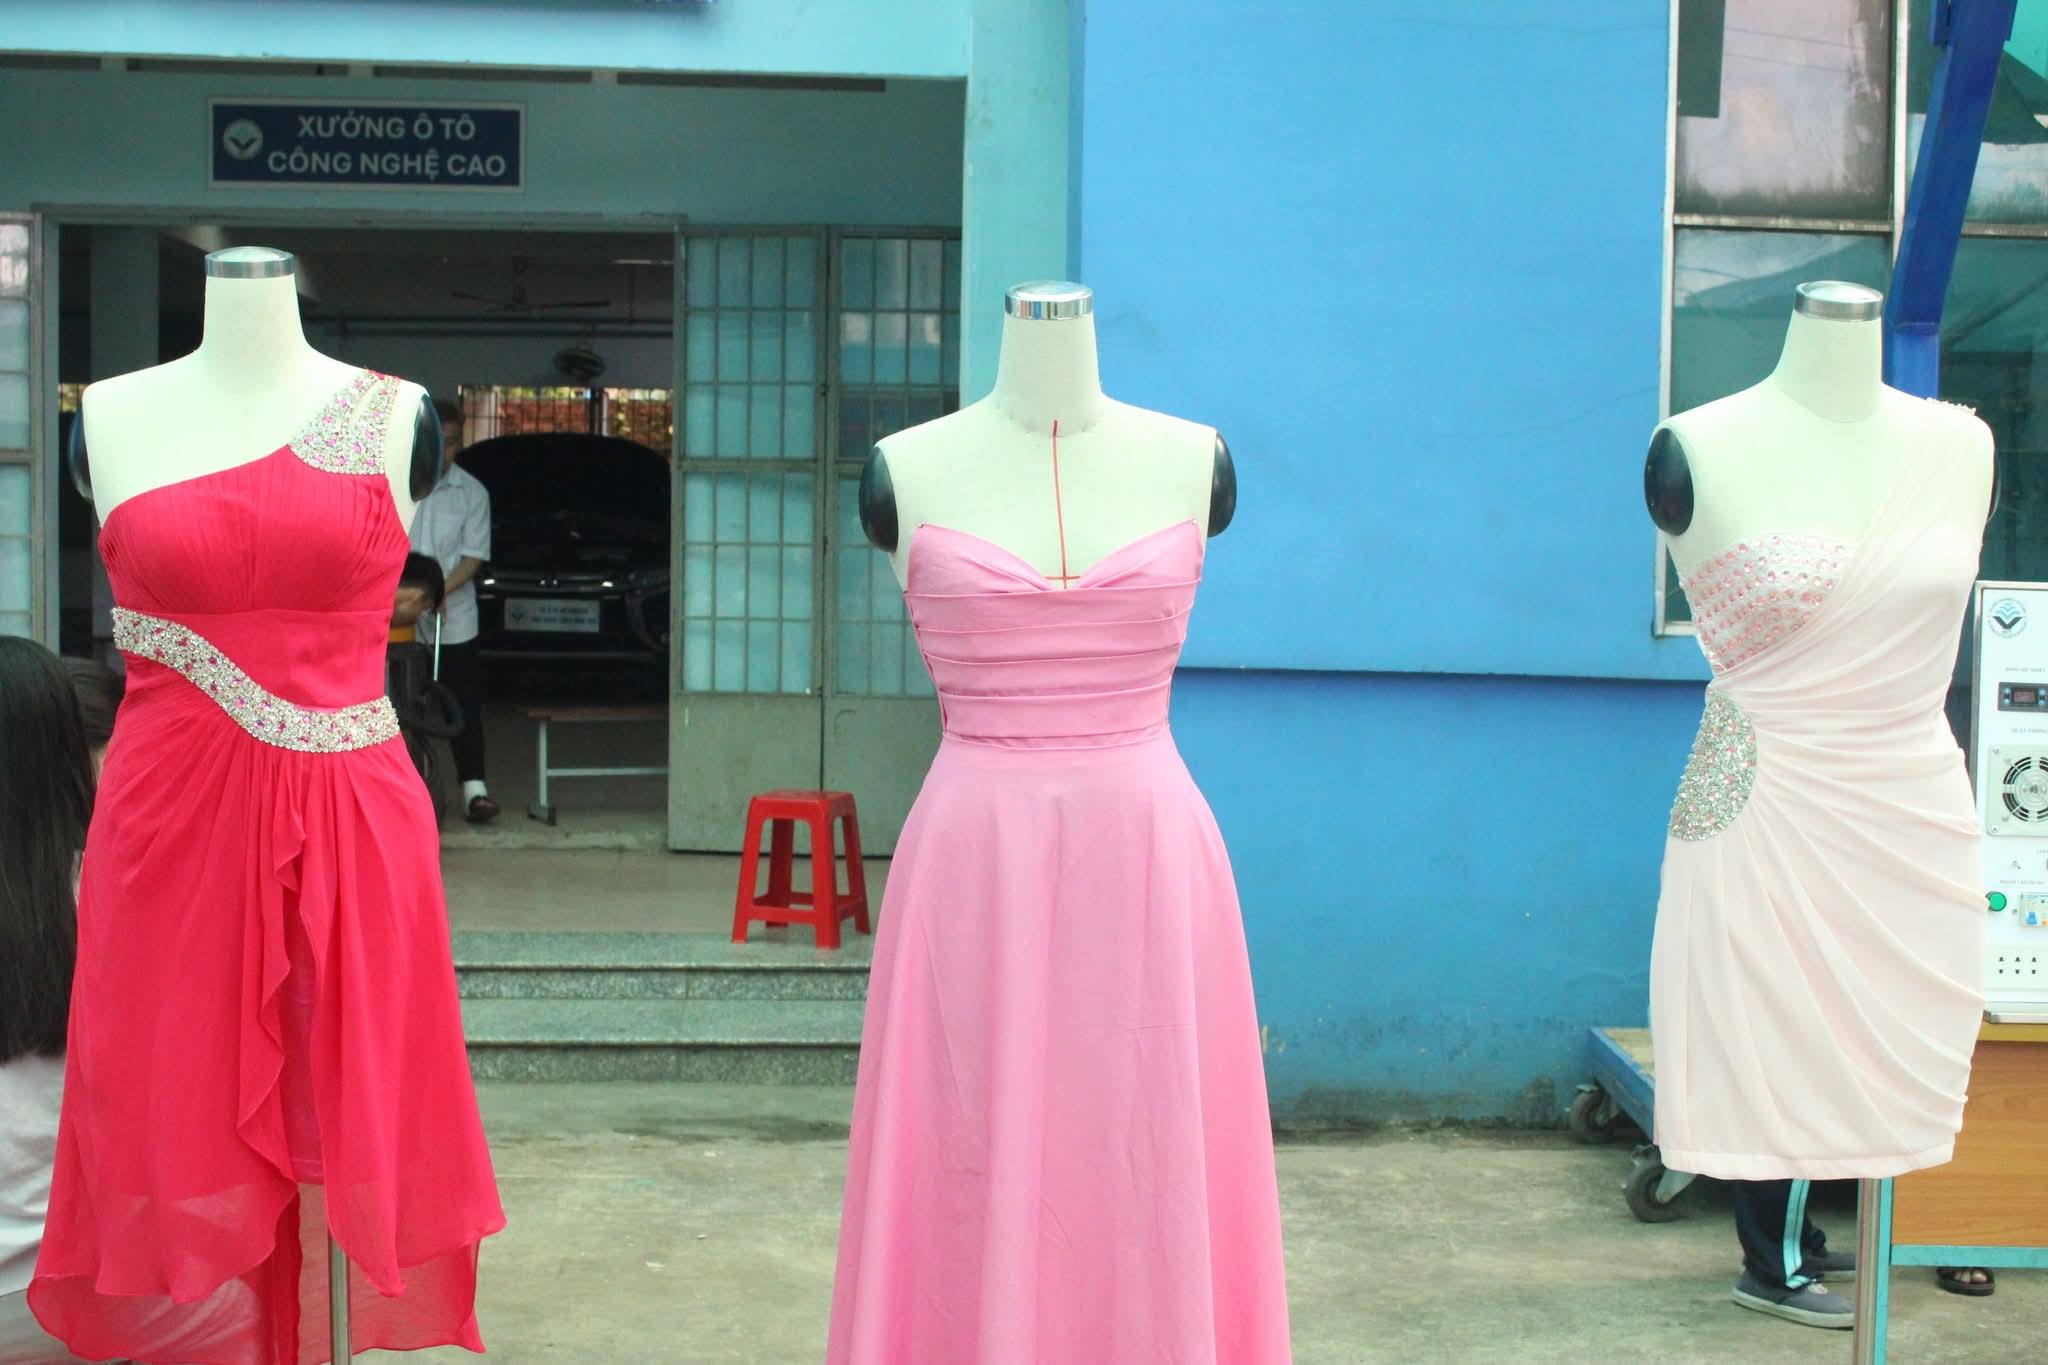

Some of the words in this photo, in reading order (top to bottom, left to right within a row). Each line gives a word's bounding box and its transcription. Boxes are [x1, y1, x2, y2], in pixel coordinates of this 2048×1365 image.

[297, 109, 406, 139] XƯỞNG
[413, 112, 434, 140] Ô
[439, 113, 476, 141] TÔ
[267, 145, 352, 174] CÔNG
[360, 147, 440, 181] NGHỆ
[446, 154, 506, 177] CAO
